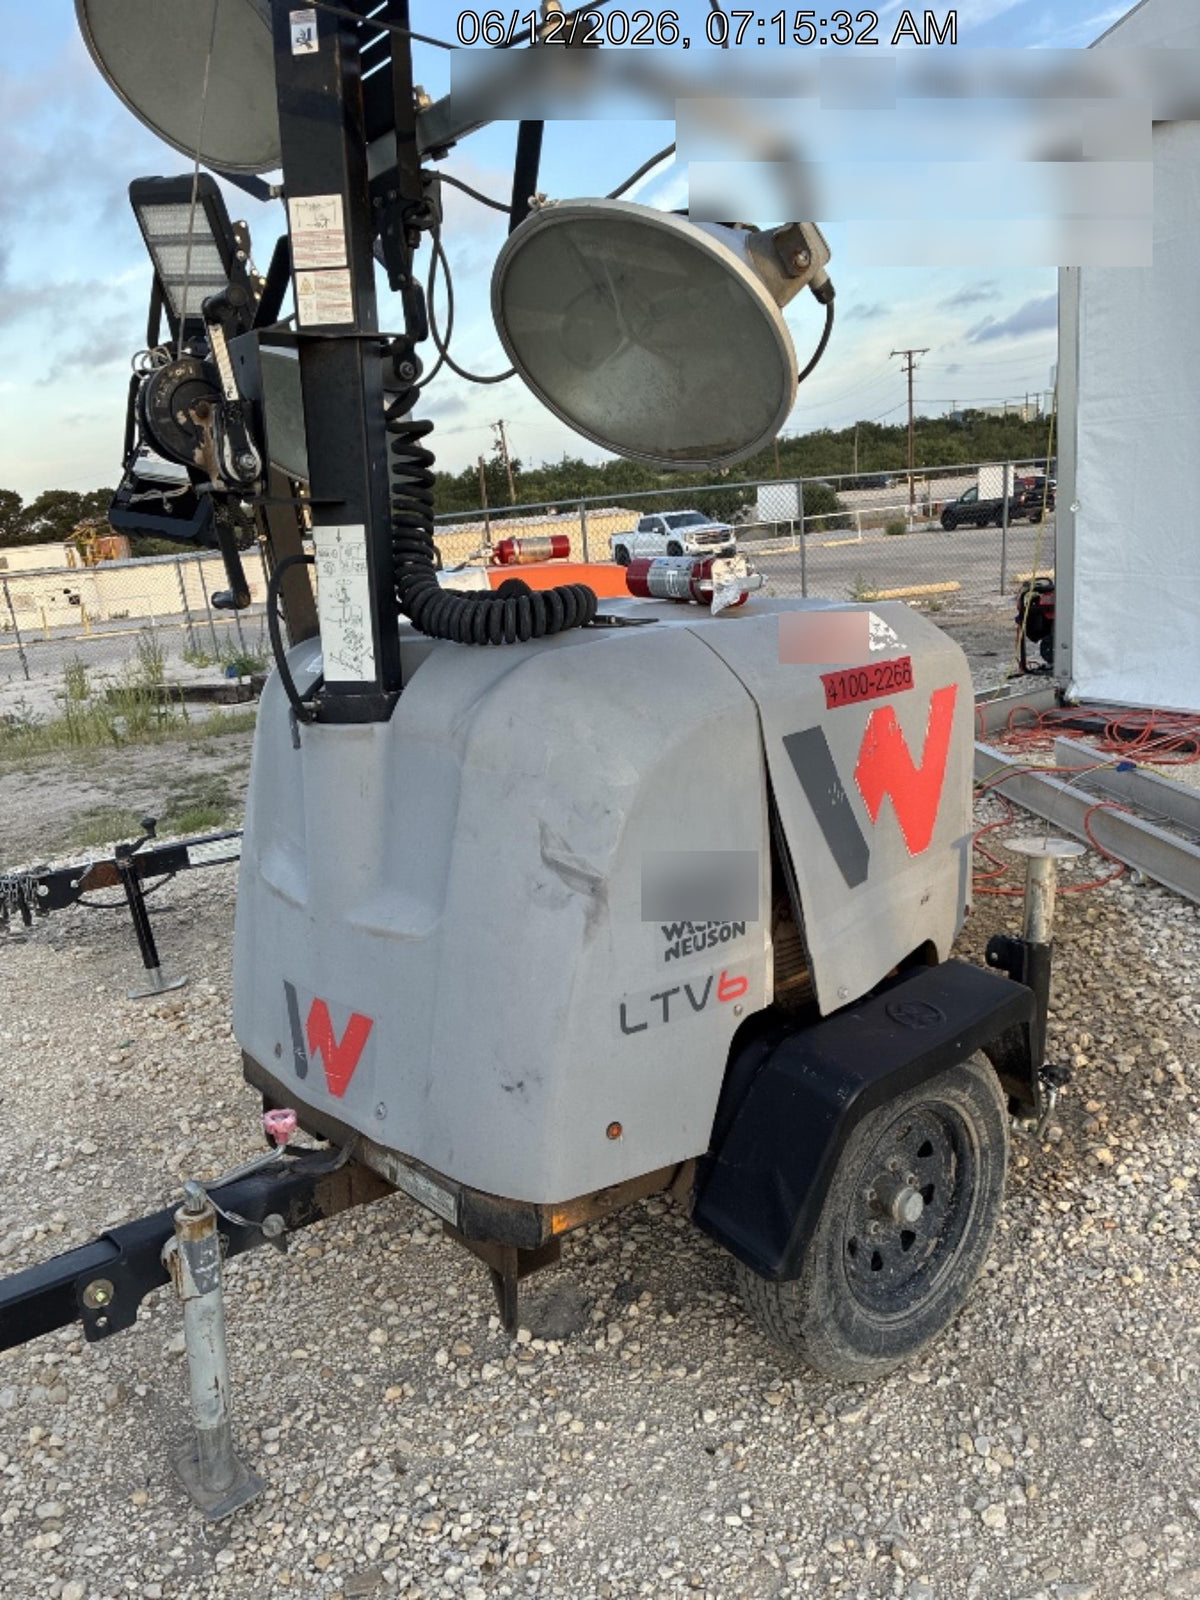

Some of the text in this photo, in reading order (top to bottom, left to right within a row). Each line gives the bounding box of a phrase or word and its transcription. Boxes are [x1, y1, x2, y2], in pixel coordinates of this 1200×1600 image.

[828, 662, 912, 703] 4100-2266
[665, 921, 745, 962] NEUSON
[620, 970, 748, 1035] LTV6
